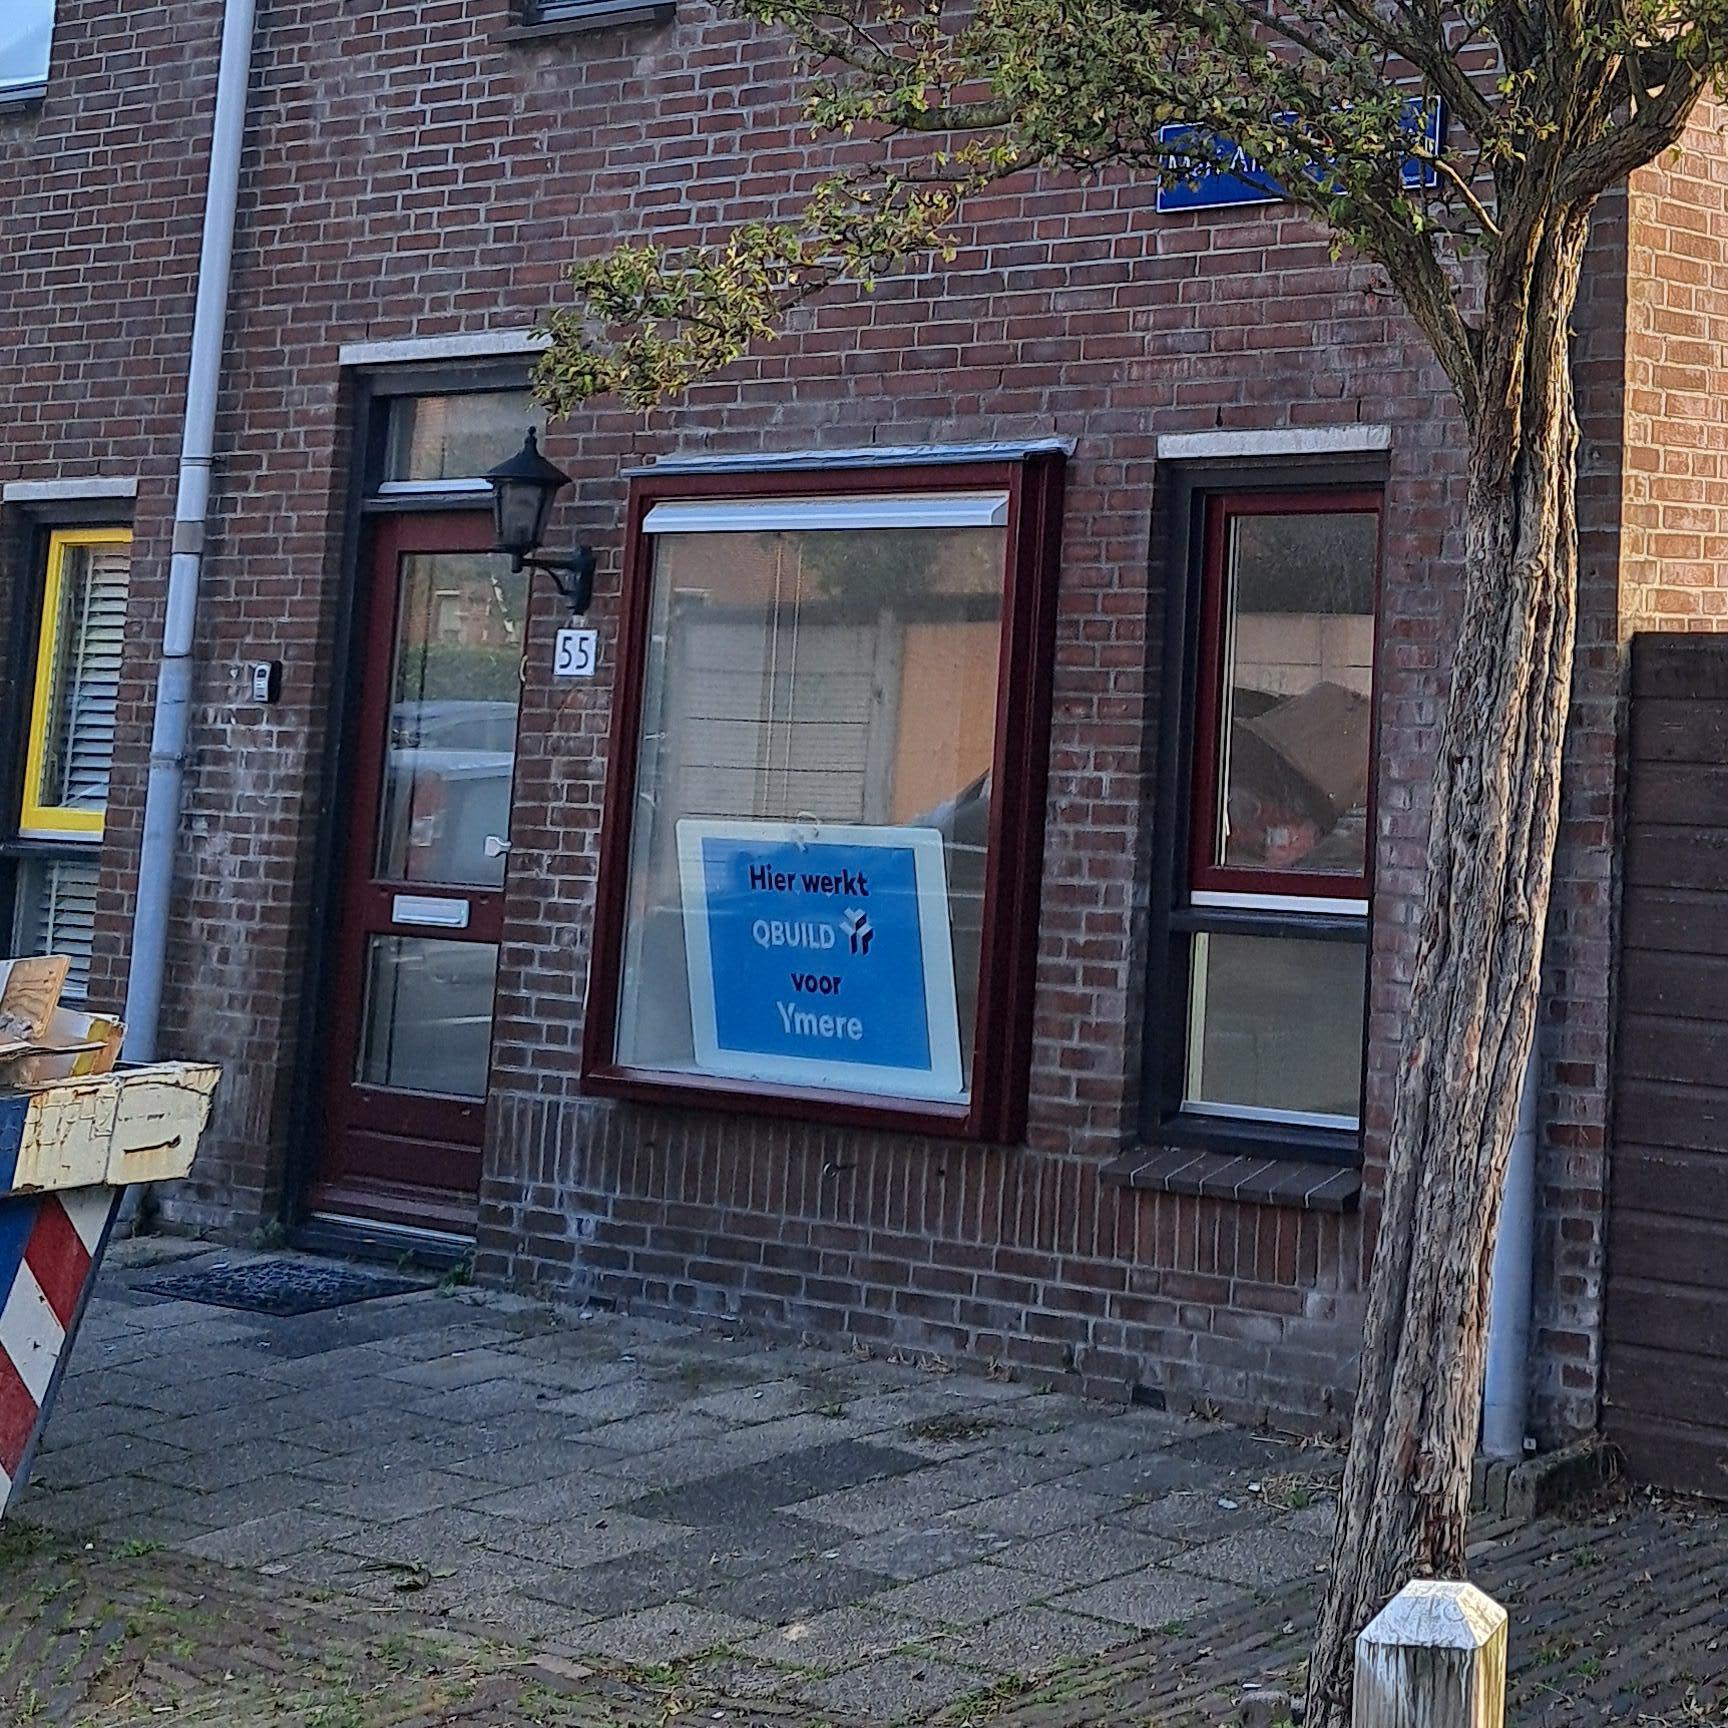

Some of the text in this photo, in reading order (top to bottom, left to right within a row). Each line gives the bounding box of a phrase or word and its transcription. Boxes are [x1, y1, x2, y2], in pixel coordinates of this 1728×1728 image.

[559, 636, 590, 669] 55
[749, 863, 869, 896] Hier werkt
[752, 920, 836, 951] QBUILD
[791, 972, 842, 995] voor
[777, 1000, 863, 1040] Ymere
